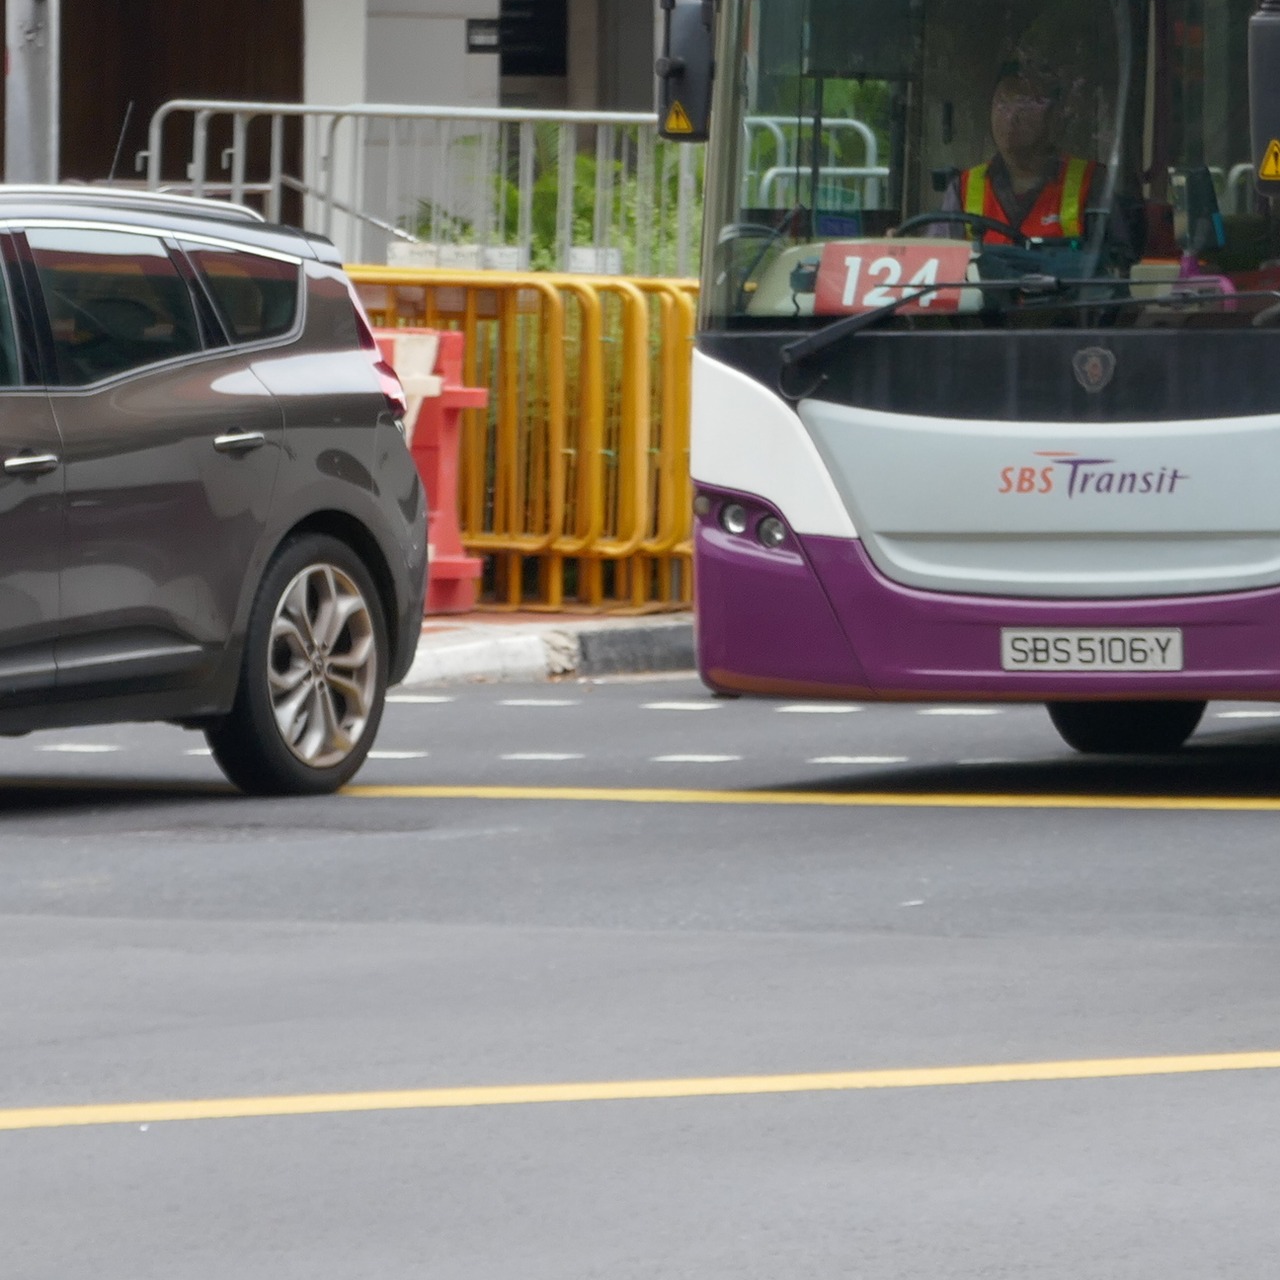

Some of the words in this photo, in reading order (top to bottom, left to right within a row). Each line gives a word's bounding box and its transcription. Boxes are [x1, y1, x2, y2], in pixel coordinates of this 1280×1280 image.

[842, 255, 940, 308] 124
[998, 465, 1055, 495] SBS
[1052, 458, 1190, 500] Transit
[1010, 636, 1172, 665] SBS5106Y
